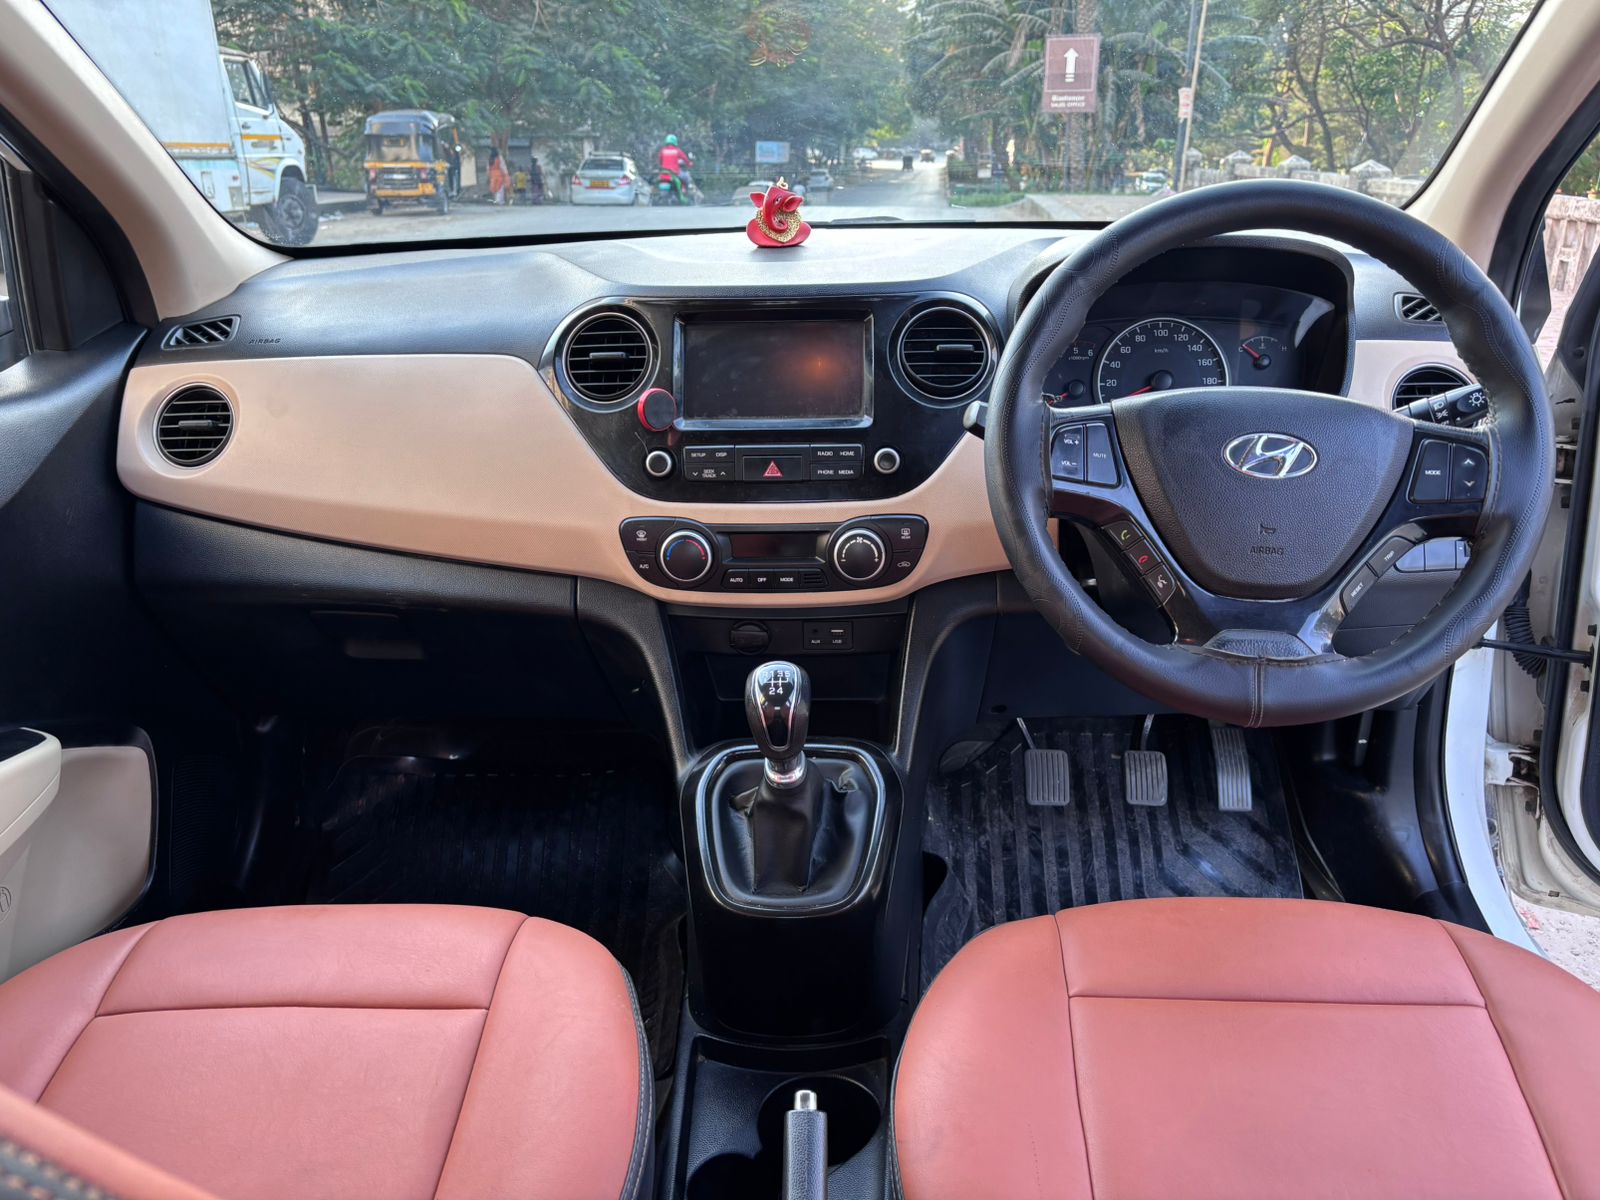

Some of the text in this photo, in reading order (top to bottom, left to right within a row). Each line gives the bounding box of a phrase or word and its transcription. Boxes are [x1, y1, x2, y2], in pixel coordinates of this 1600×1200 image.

[1250, 546, 1284, 555] AIRBAG
[1384, 550, 1394, 560] TRIP
[768, 686, 784, 695] 2 4
